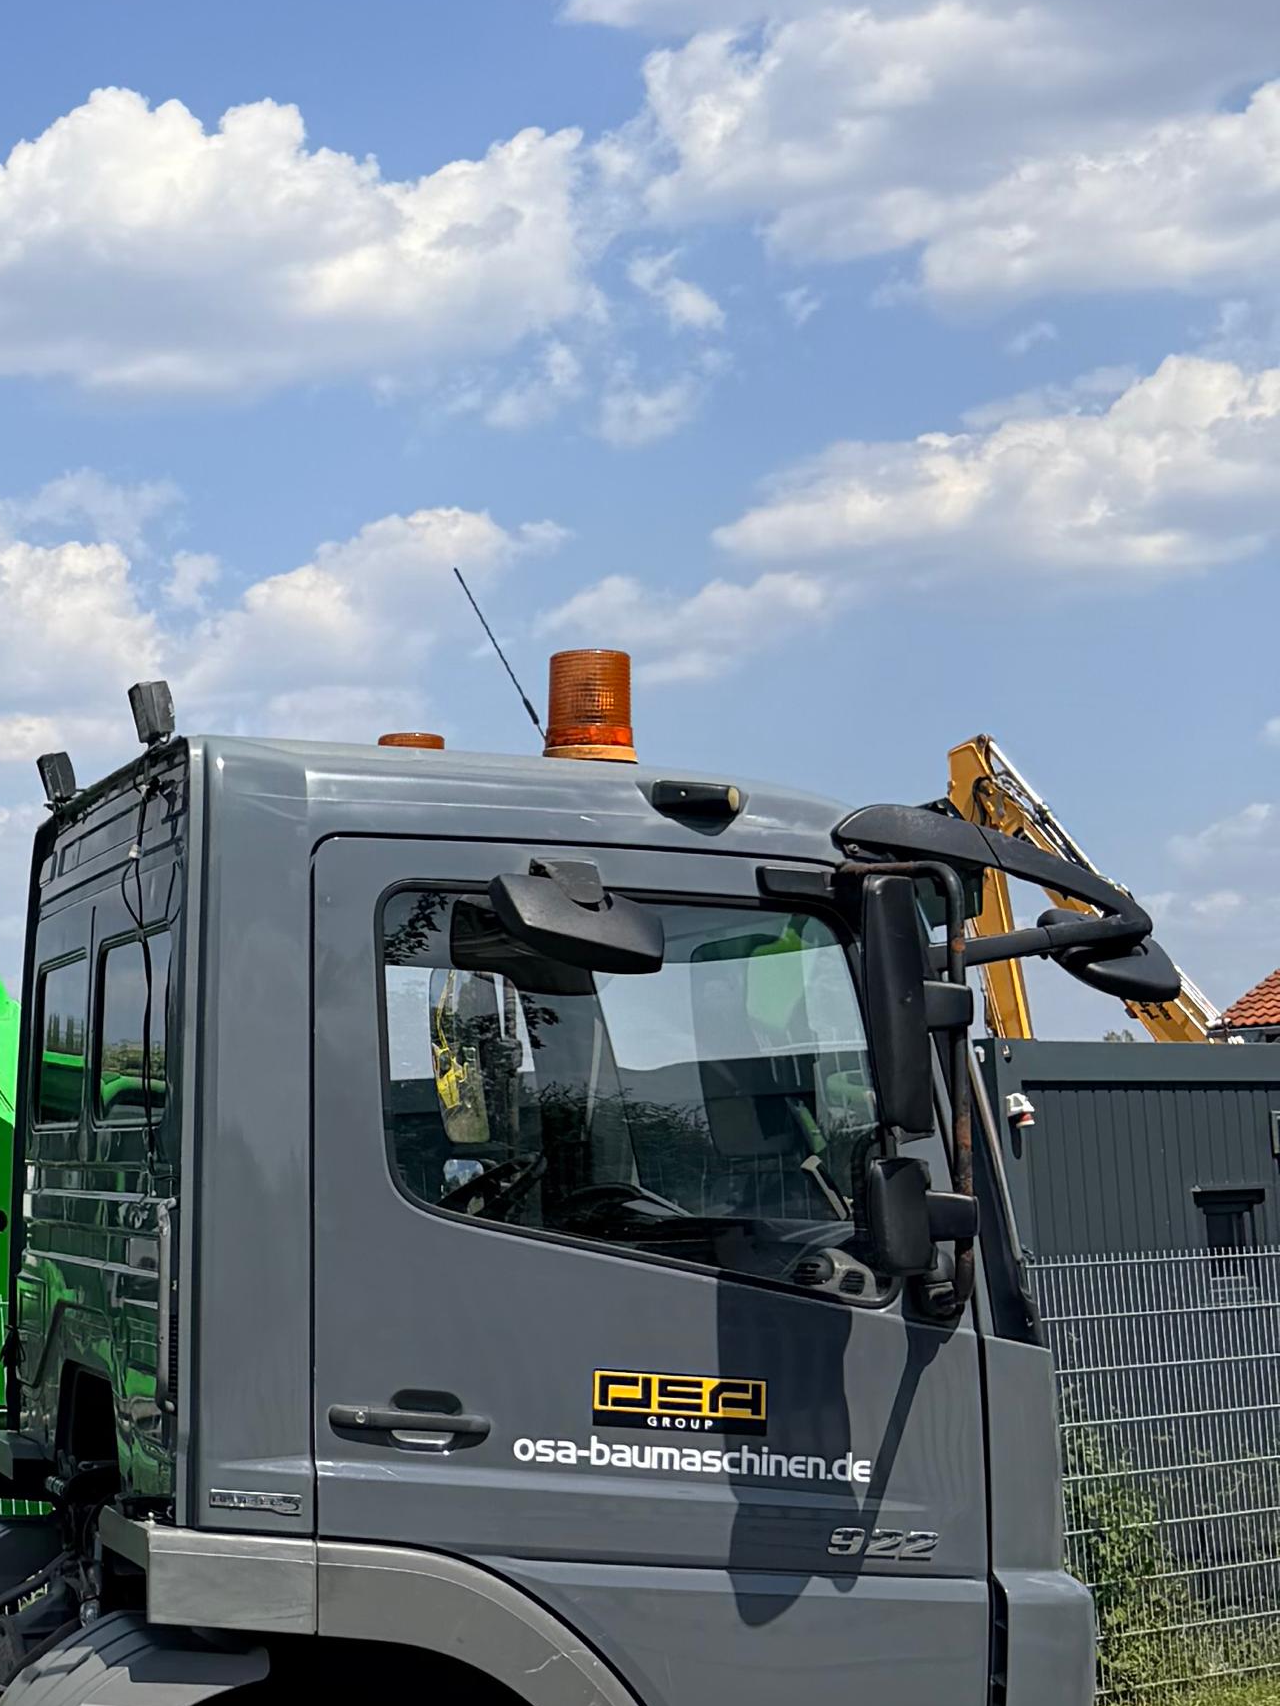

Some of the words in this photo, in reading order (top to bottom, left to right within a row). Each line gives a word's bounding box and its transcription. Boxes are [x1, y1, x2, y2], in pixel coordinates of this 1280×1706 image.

[646, 1415, 715, 1431] GROUP
[513, 1435, 872, 1484] osa-baumaschinen.de
[826, 1526, 940, 1562] 922
